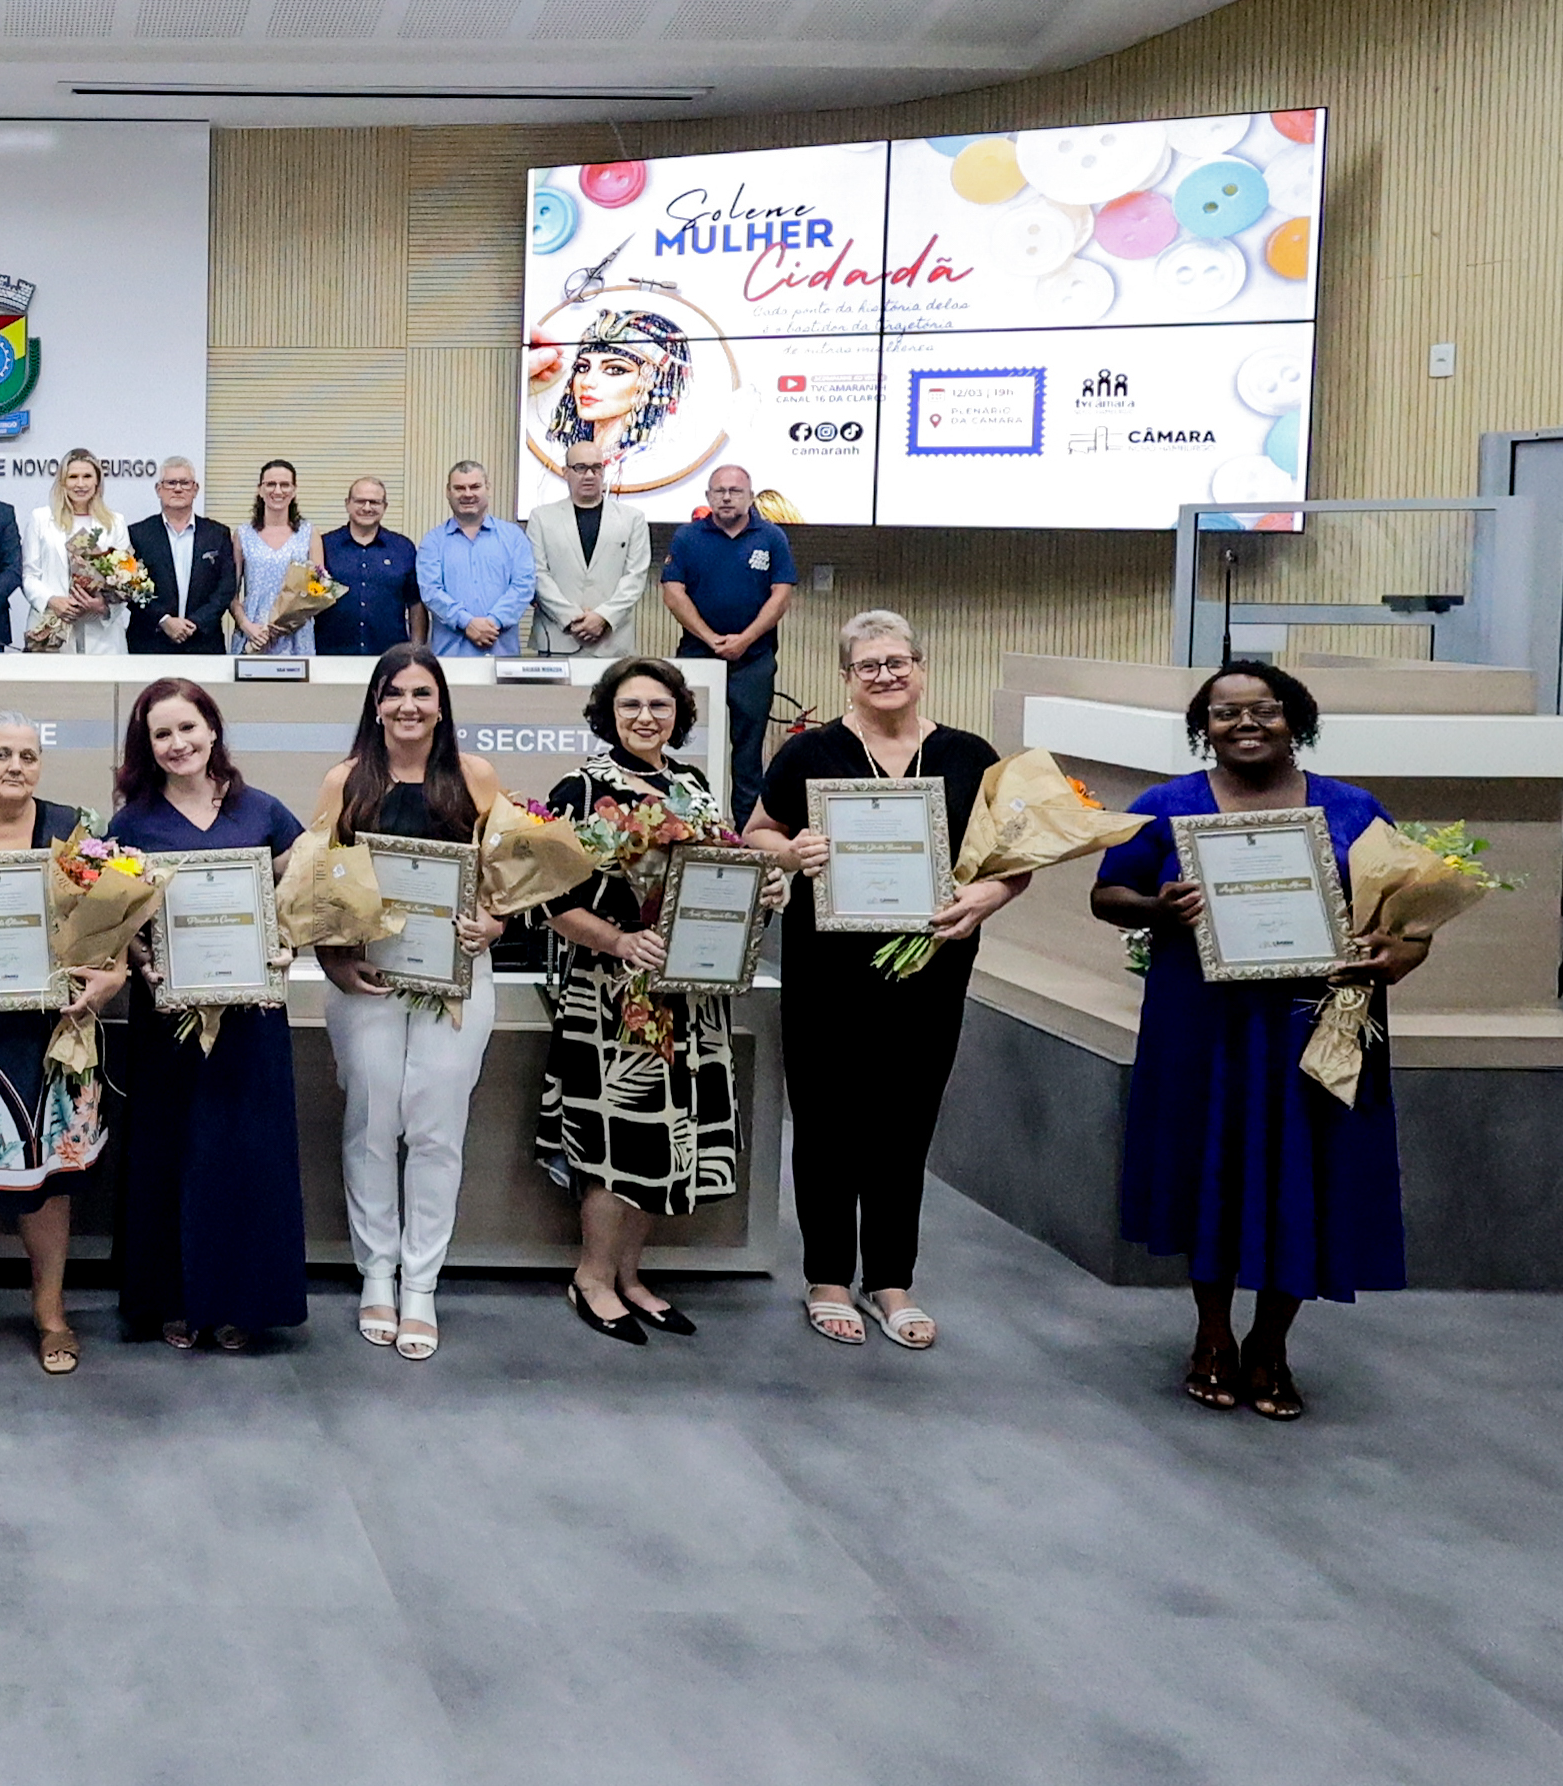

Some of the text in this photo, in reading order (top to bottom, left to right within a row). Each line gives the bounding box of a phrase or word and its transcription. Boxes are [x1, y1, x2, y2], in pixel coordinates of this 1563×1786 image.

[666, 182, 816, 232] Solene
[655, 217, 834, 256] MULHER
[744, 233, 974, 302] Cidadã
[1128, 427, 1217, 444] CÂMARA
[792, 445, 860, 456] camaranh
[12, 458, 59, 477] NOVO
